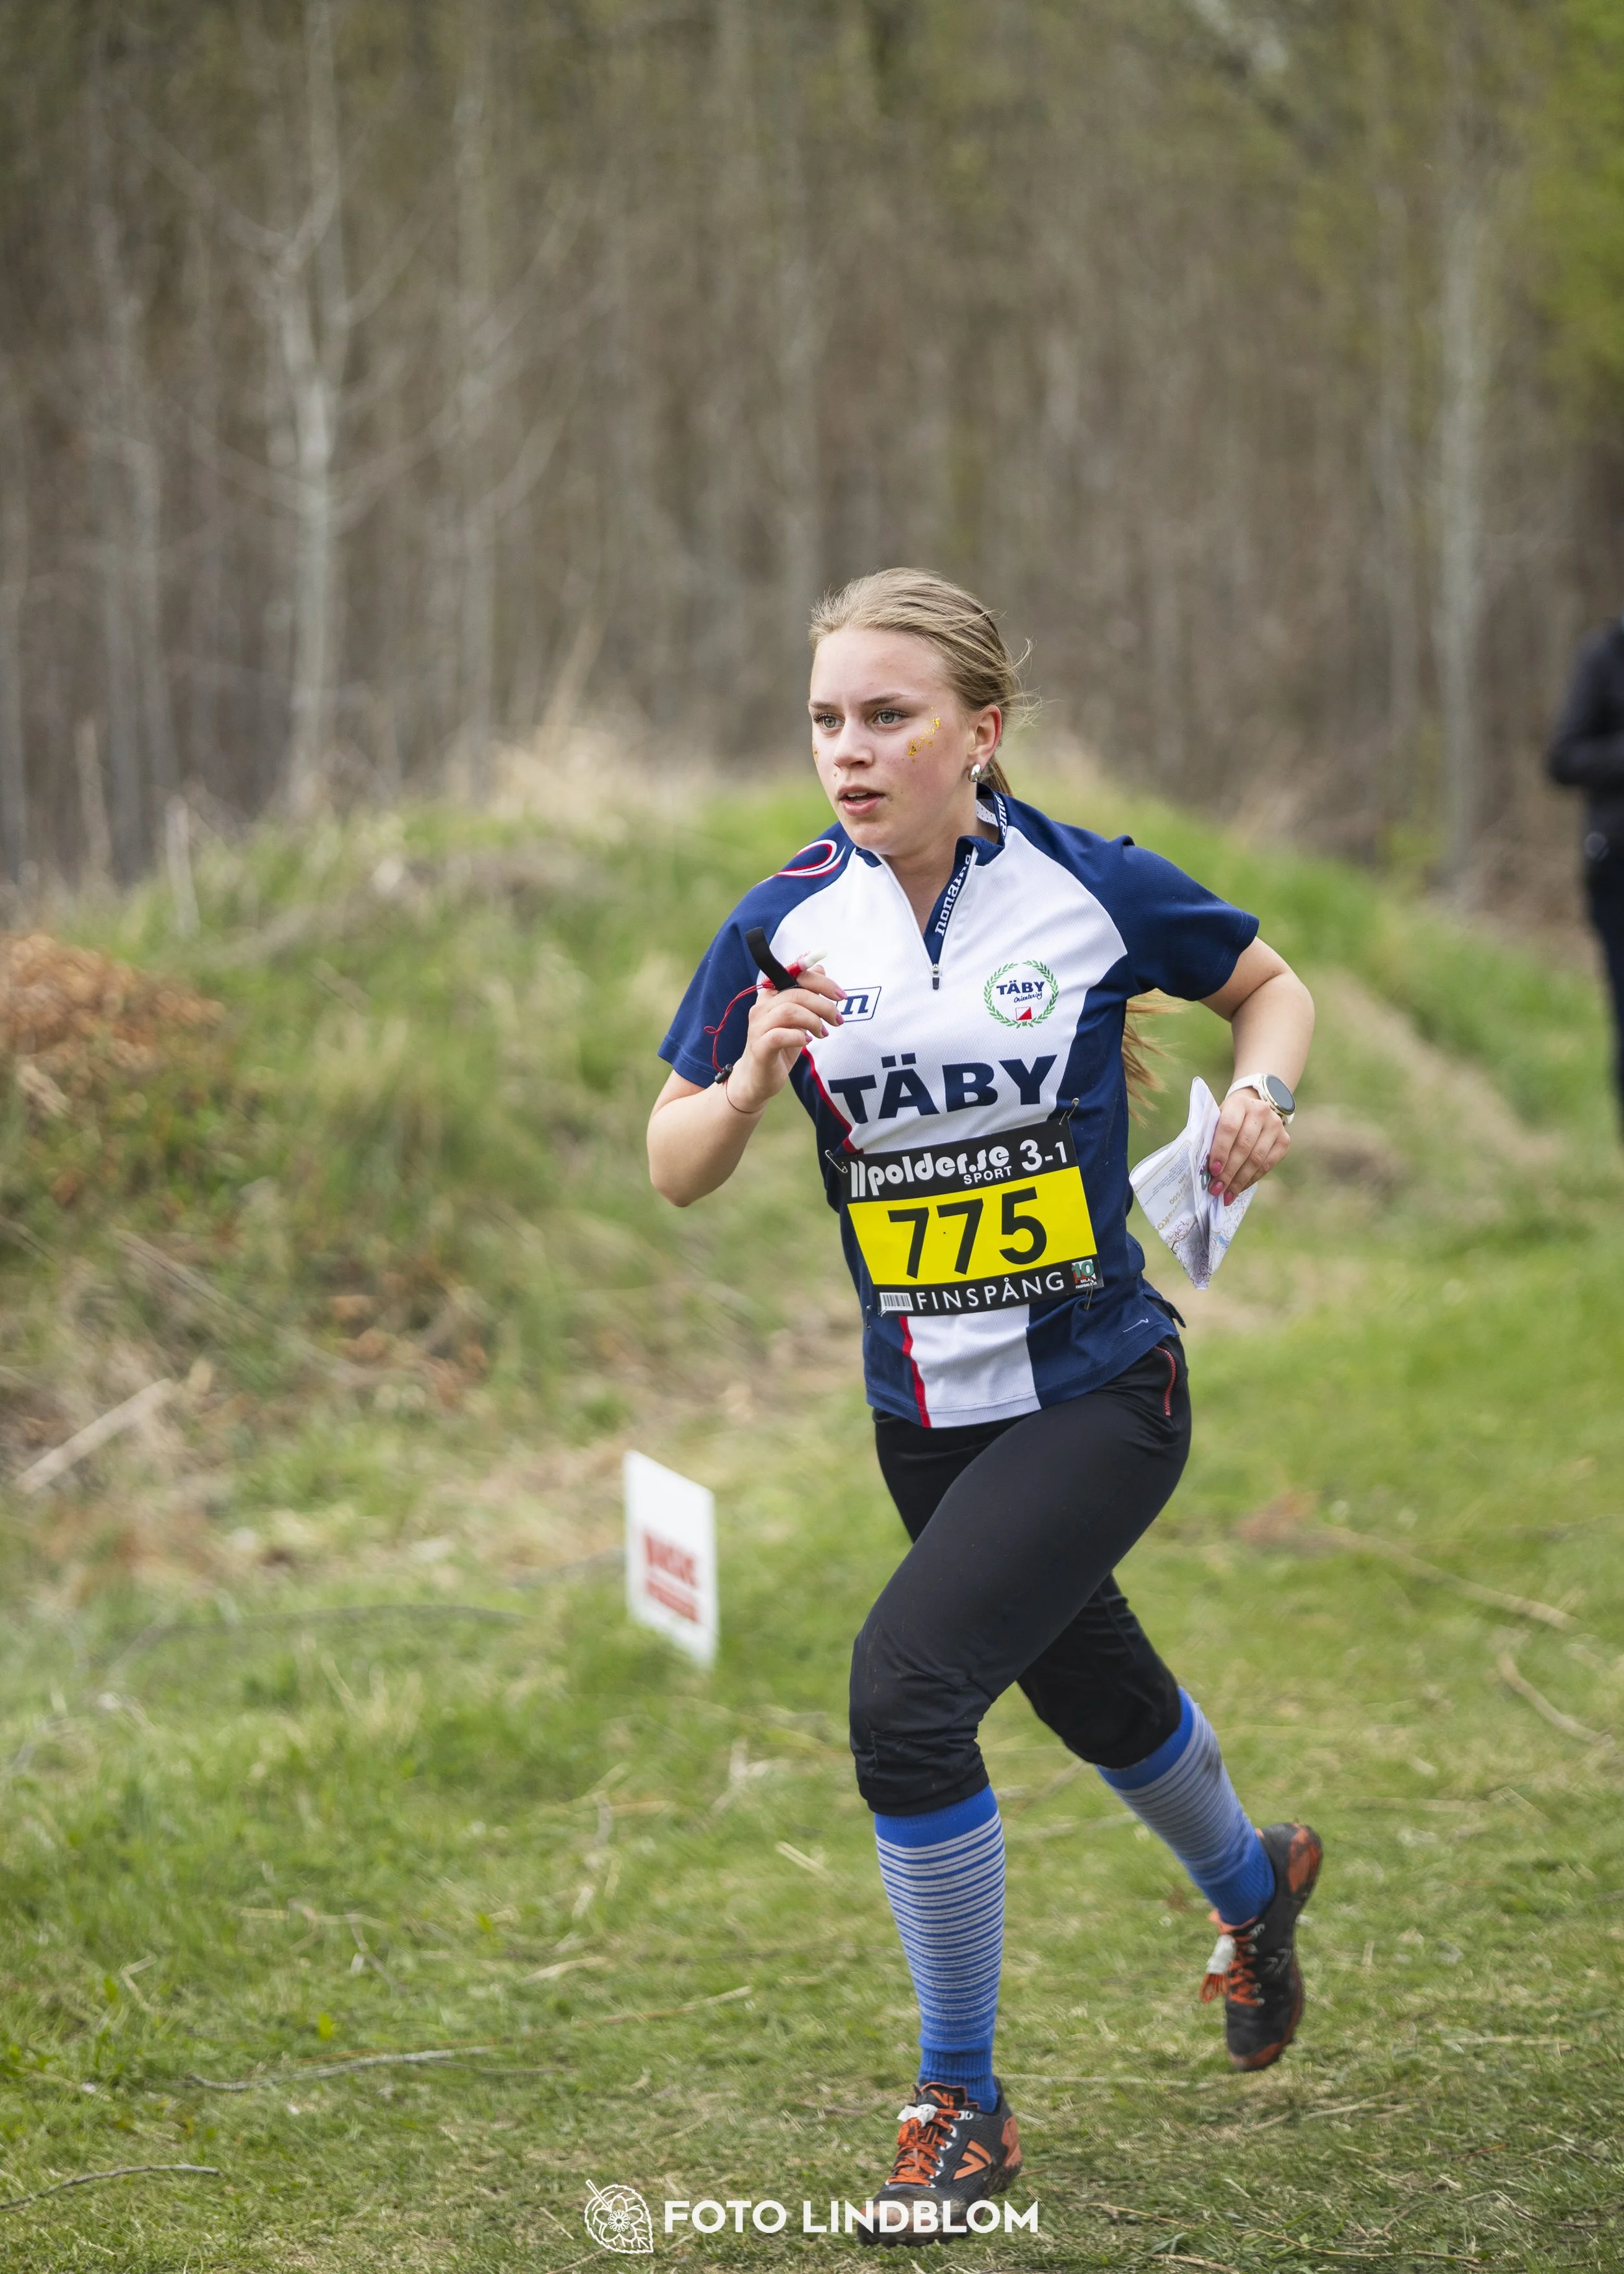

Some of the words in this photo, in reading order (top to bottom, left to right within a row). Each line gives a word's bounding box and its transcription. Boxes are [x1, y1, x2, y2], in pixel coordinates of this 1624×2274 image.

[996, 979, 1045, 995] TÄBY
[1013, 991, 1043, 1003] Orientering
[828, 1053, 1058, 1124] TÄBY
[1019, 1139, 1067, 1171] 3-1
[963, 1166, 1012, 1185] SPORT
[887, 1186, 1048, 1279] 775
[1071, 1260, 1095, 1279] 10
[915, 1271, 1065, 1310] FINSPÅNG
